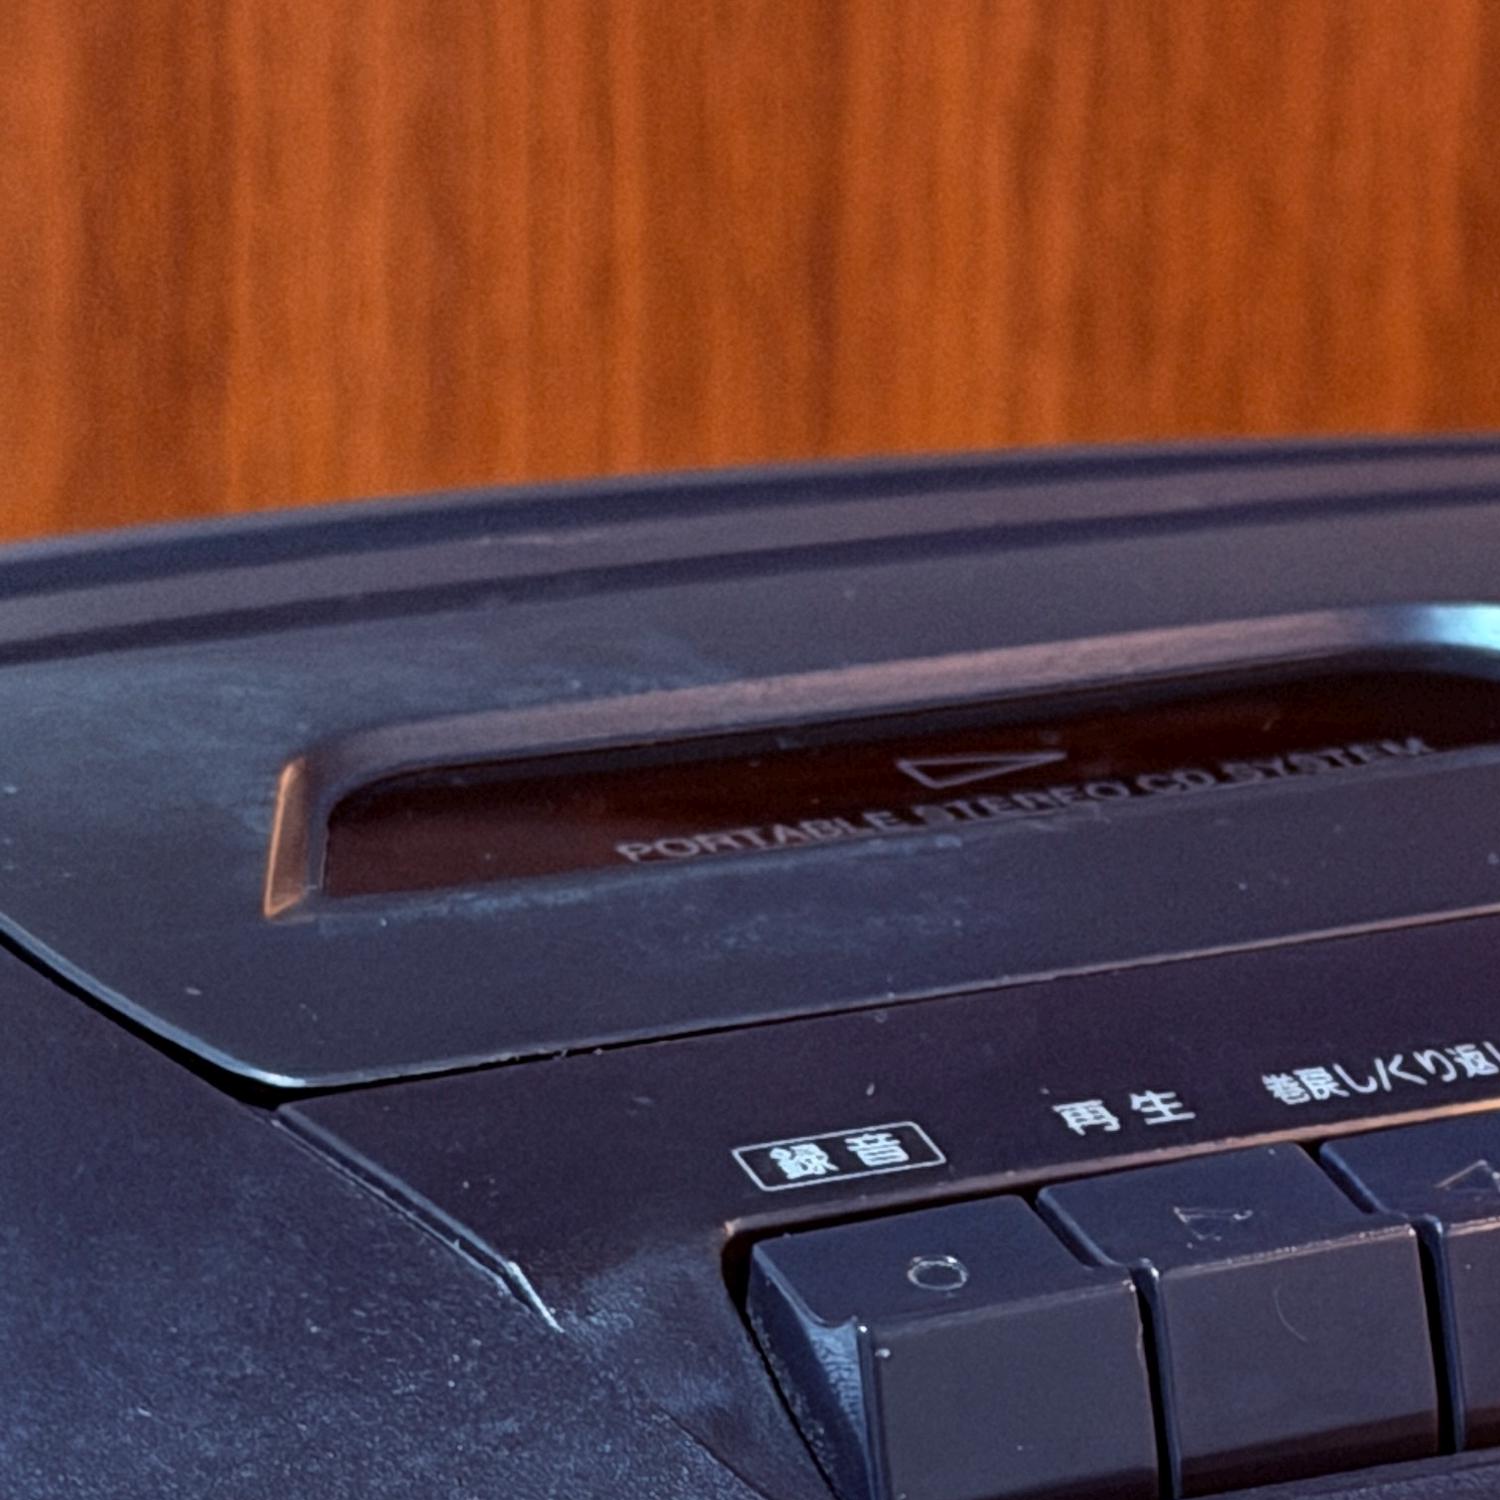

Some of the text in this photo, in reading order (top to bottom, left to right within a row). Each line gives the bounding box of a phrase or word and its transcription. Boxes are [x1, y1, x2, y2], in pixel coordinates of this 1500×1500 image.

[615, 810, 901, 863] PORTABLE
[1137, 767, 1215, 795] CD
[1052, 1089, 1196, 1137] 再生
[769, 1131, 909, 1180] 録音
